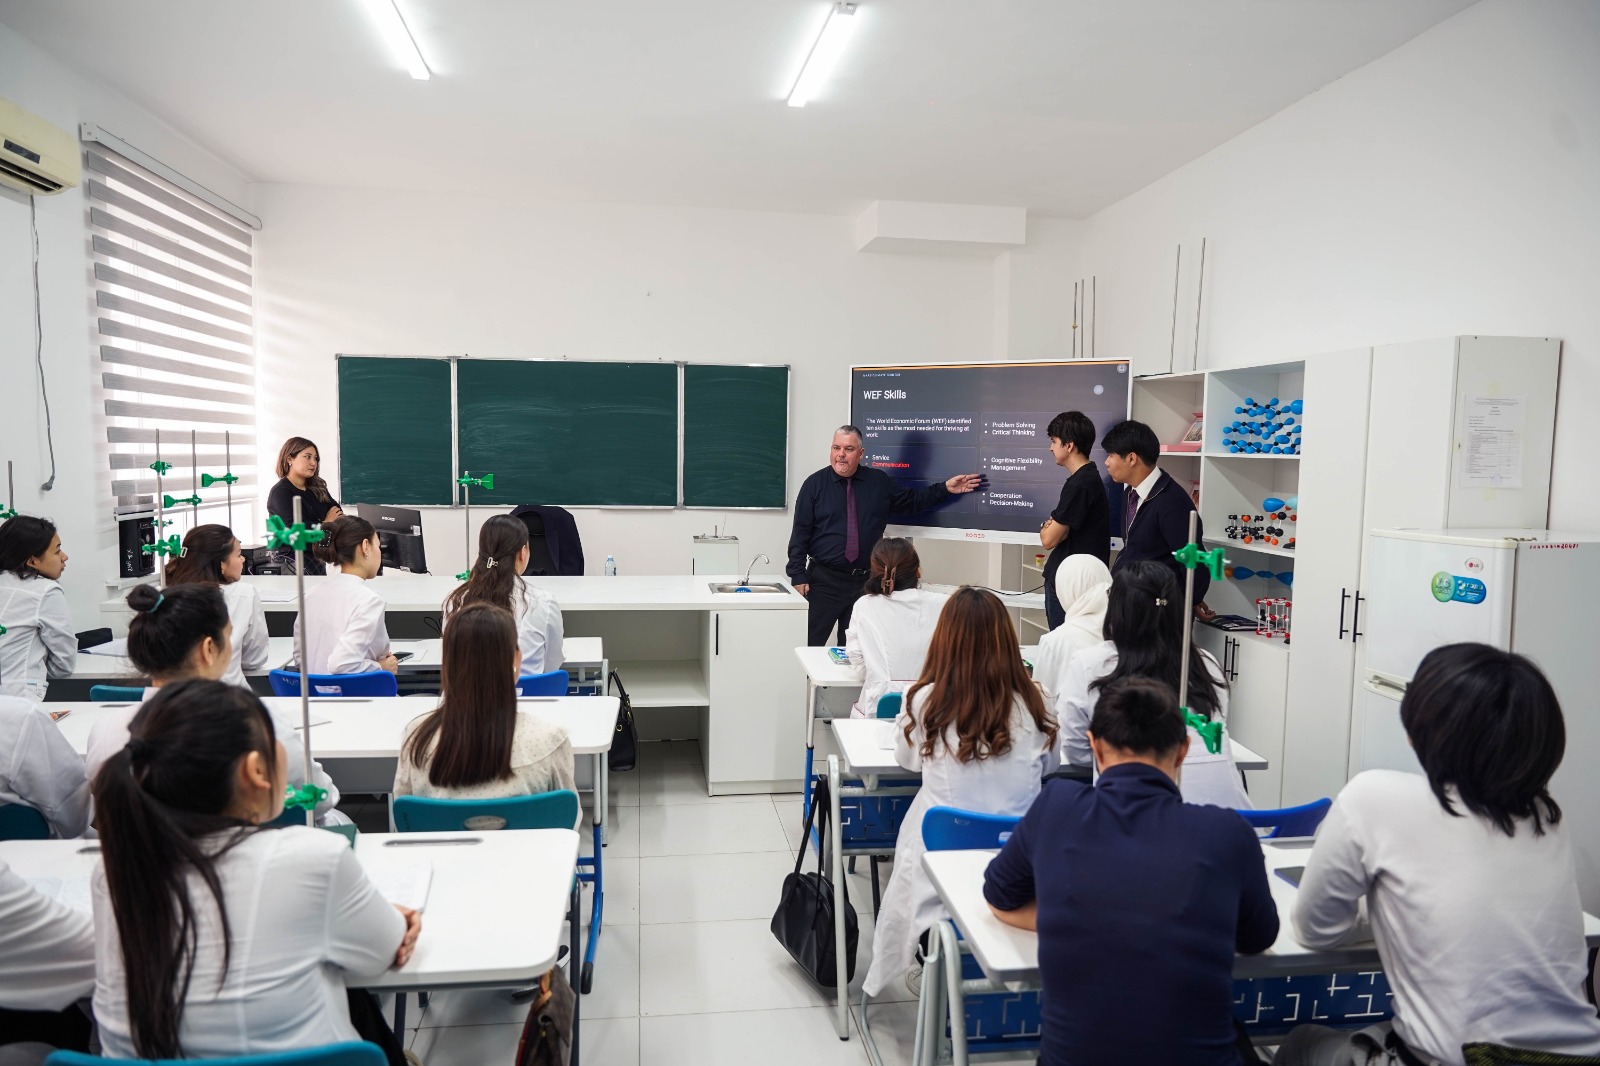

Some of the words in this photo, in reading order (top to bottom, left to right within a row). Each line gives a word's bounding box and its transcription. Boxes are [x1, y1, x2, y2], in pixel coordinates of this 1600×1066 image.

[863, 390, 882, 399] WEF
[884, 389, 907, 399] Skills
[944, 425, 963, 433] thriving
[1015, 421, 1036, 429] Solving
[1016, 457, 1043, 465] Flexibility
[989, 499, 1034, 508] Decision-Making
